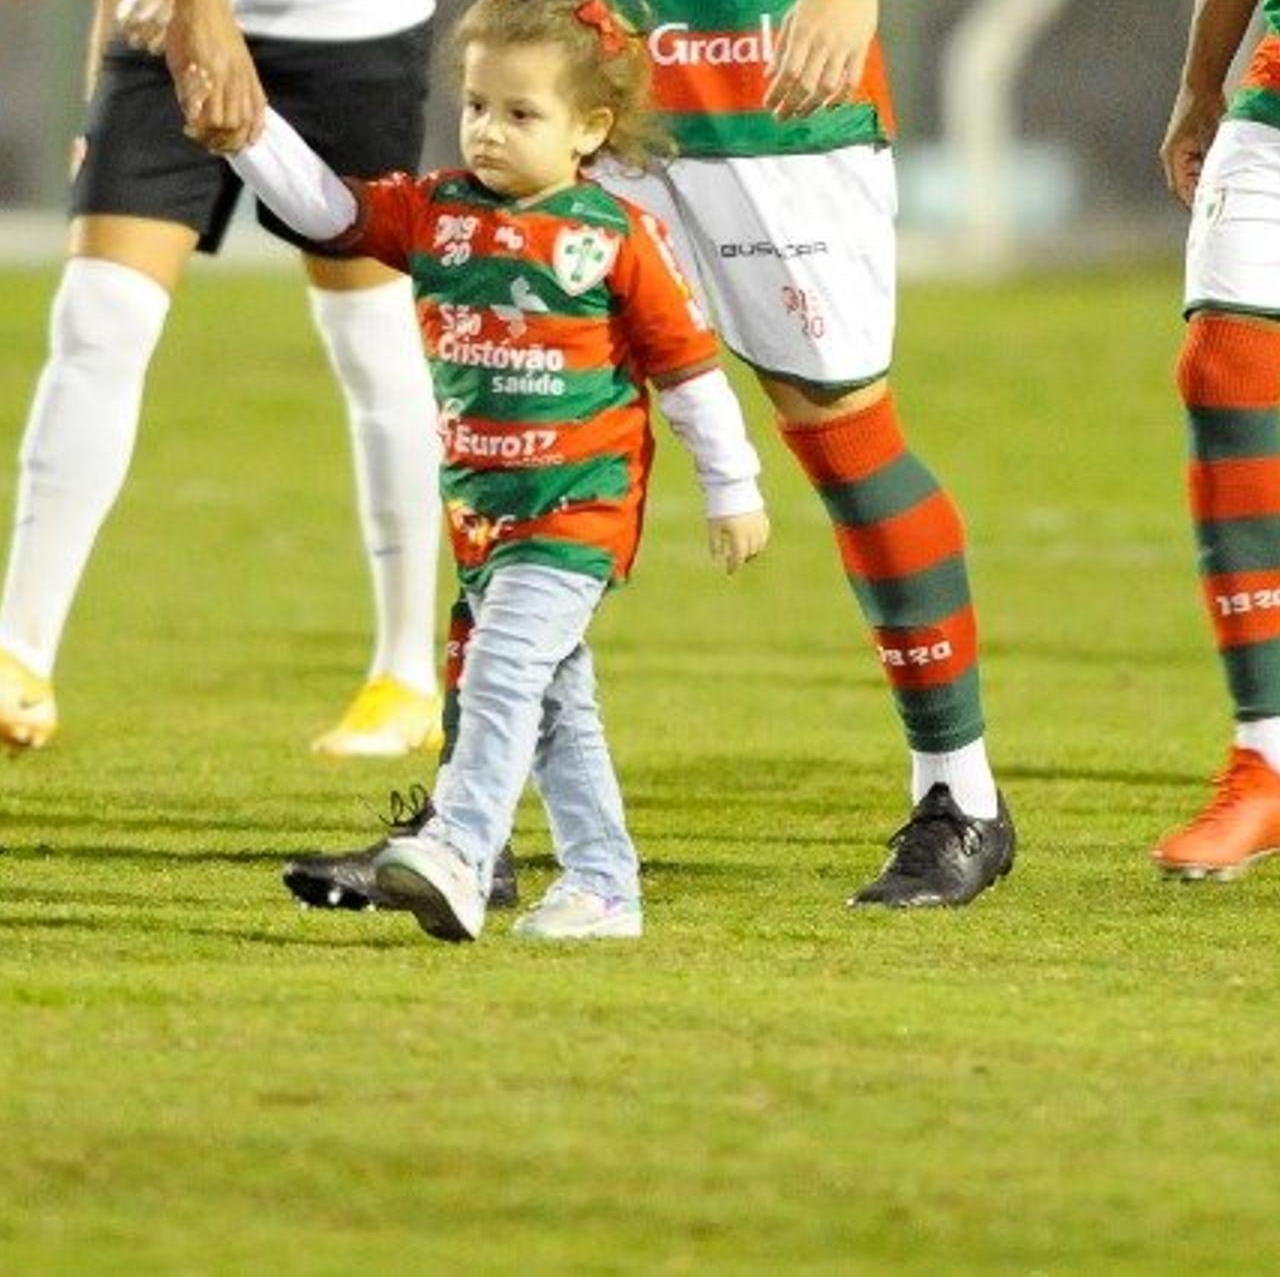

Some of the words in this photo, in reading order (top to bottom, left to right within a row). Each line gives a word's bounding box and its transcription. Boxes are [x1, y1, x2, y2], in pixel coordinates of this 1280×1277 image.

[649, 13, 774, 66] Graal
[438, 304, 483, 336] São
[438, 331, 566, 372] Cristóvão
[491, 370, 566, 396] saúde
[453, 424, 559, 459] Euro17
